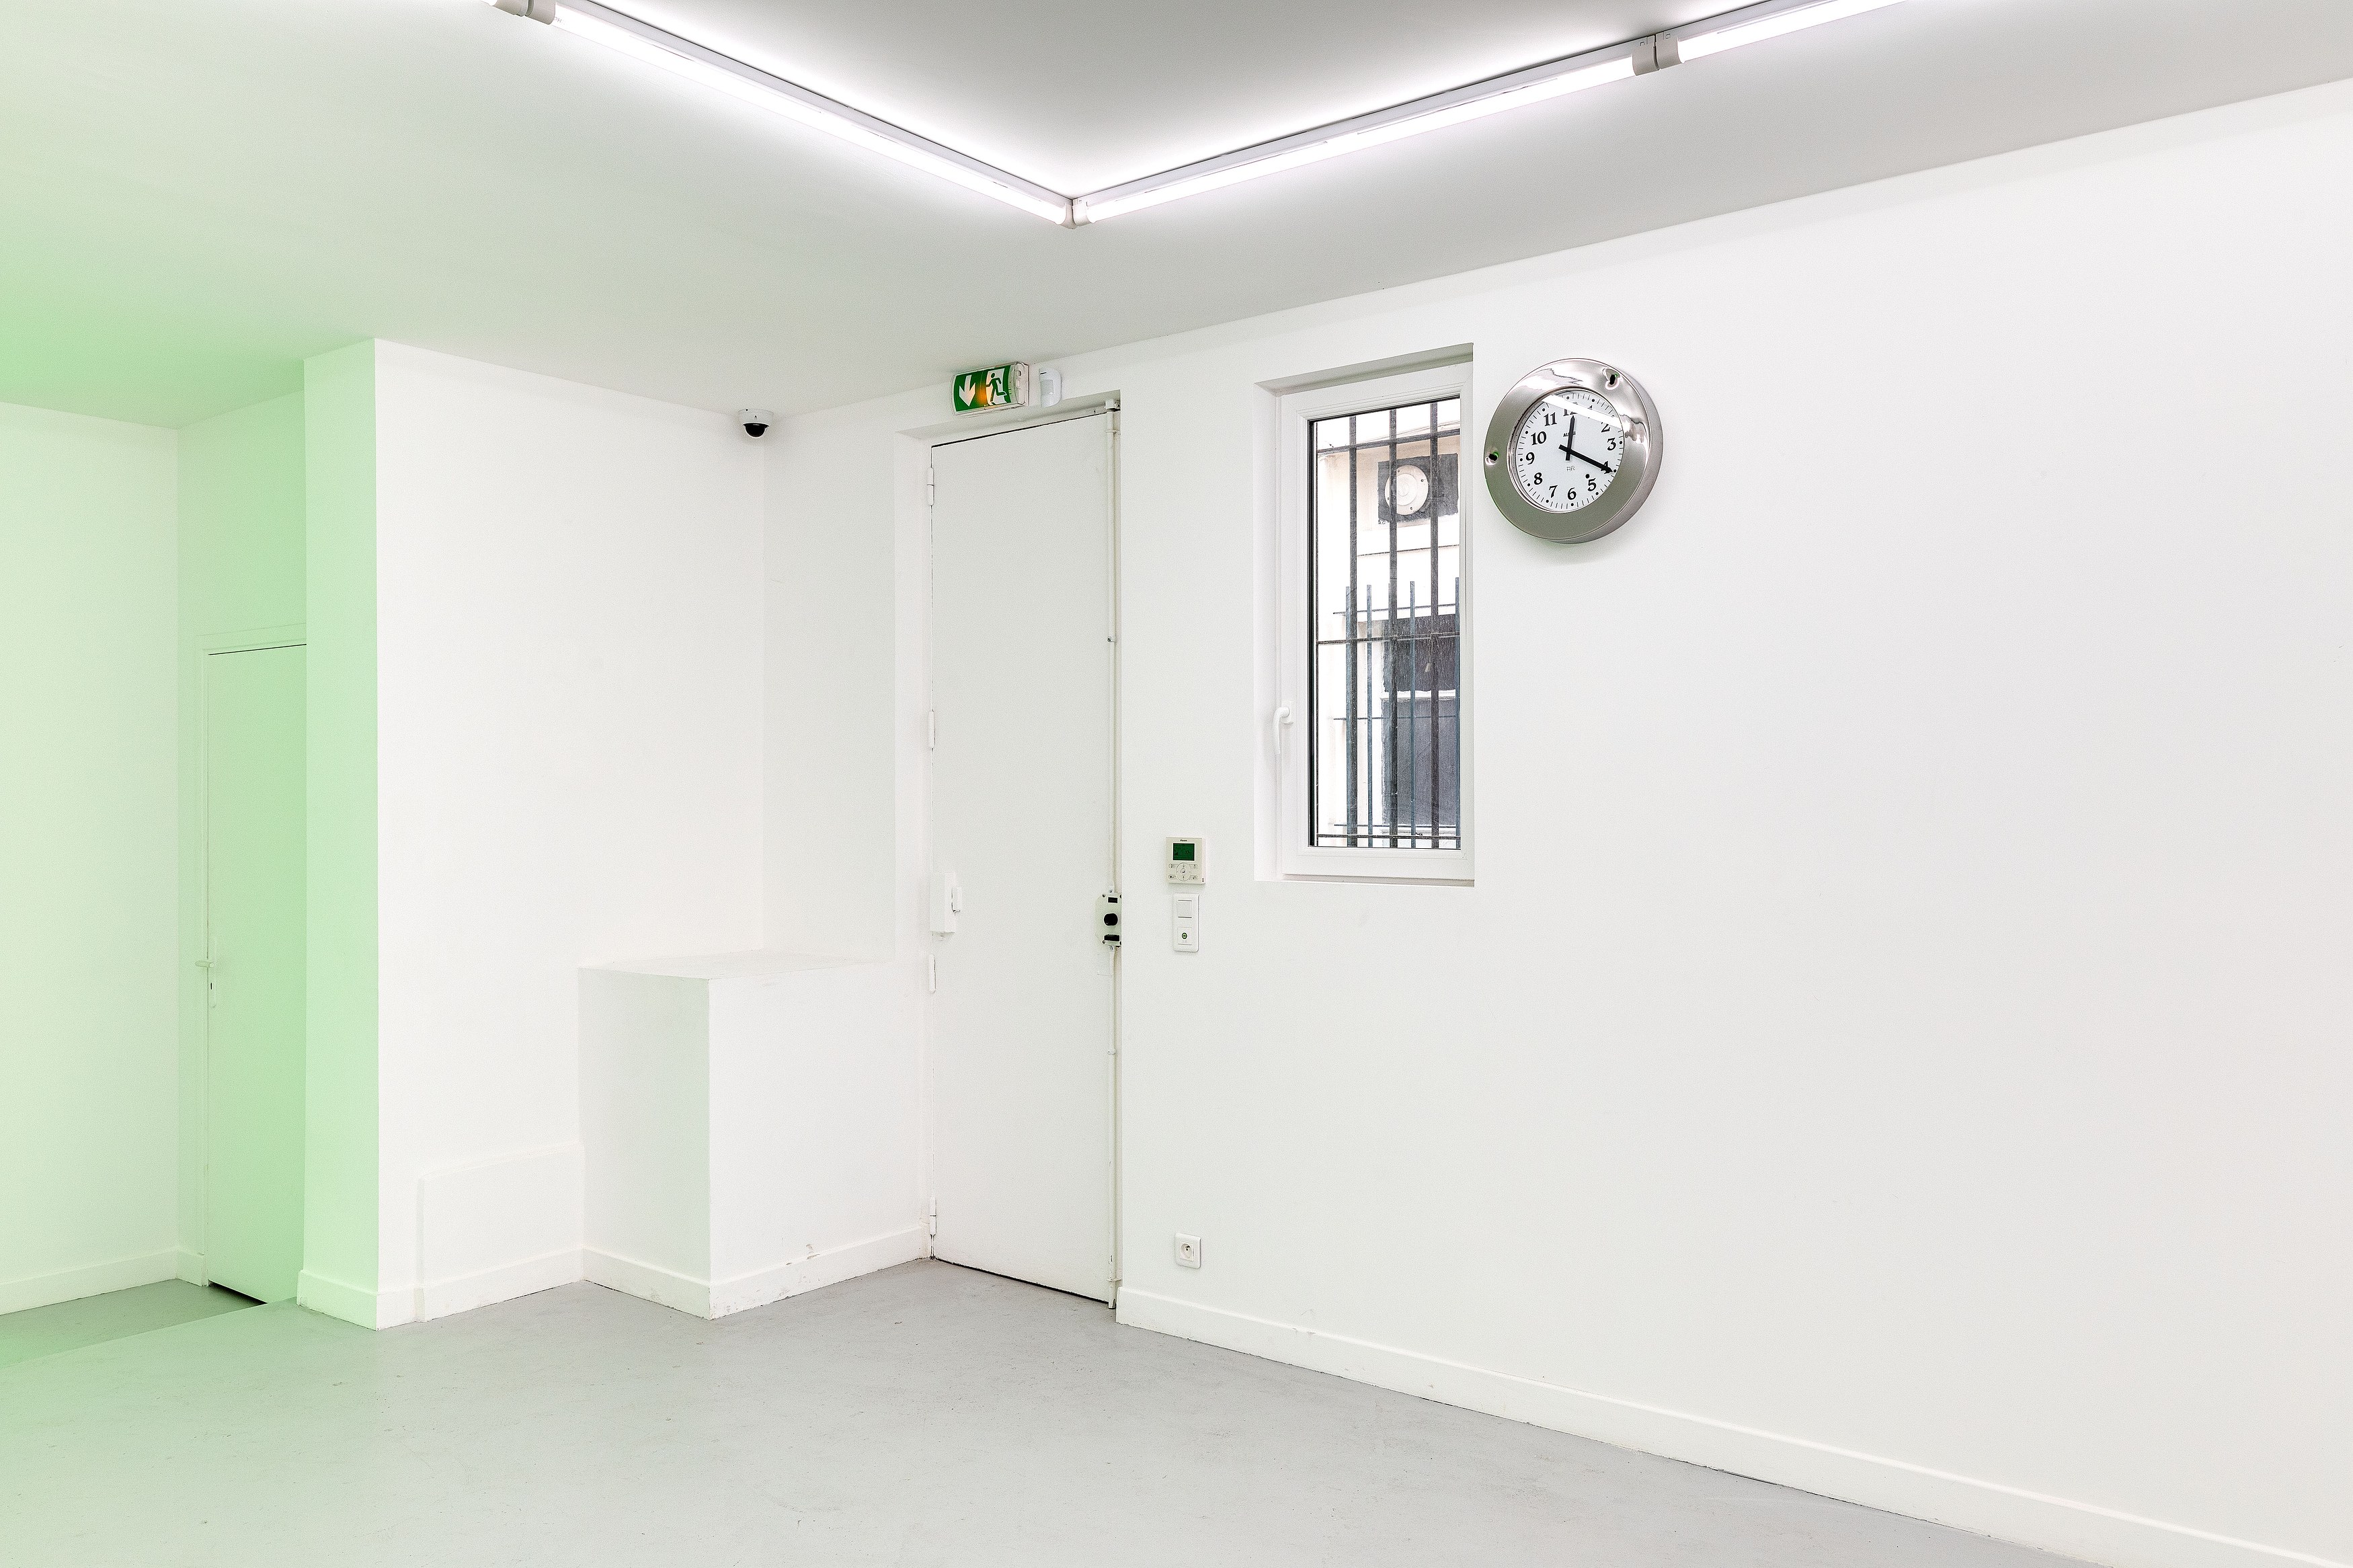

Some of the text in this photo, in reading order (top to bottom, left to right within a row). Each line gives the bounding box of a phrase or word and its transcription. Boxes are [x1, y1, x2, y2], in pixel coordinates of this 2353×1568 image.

[1544, 412, 1557, 426] 11
[1531, 431, 1547, 445] 10
[1607, 437, 1616, 451] 3
[1526, 452, 1535, 465] 9
[1534, 472, 1543, 485] 8
[1587, 477, 1597, 491] 5
[1549, 485, 1558, 498] 7
[1567, 487, 1577, 500] 6
